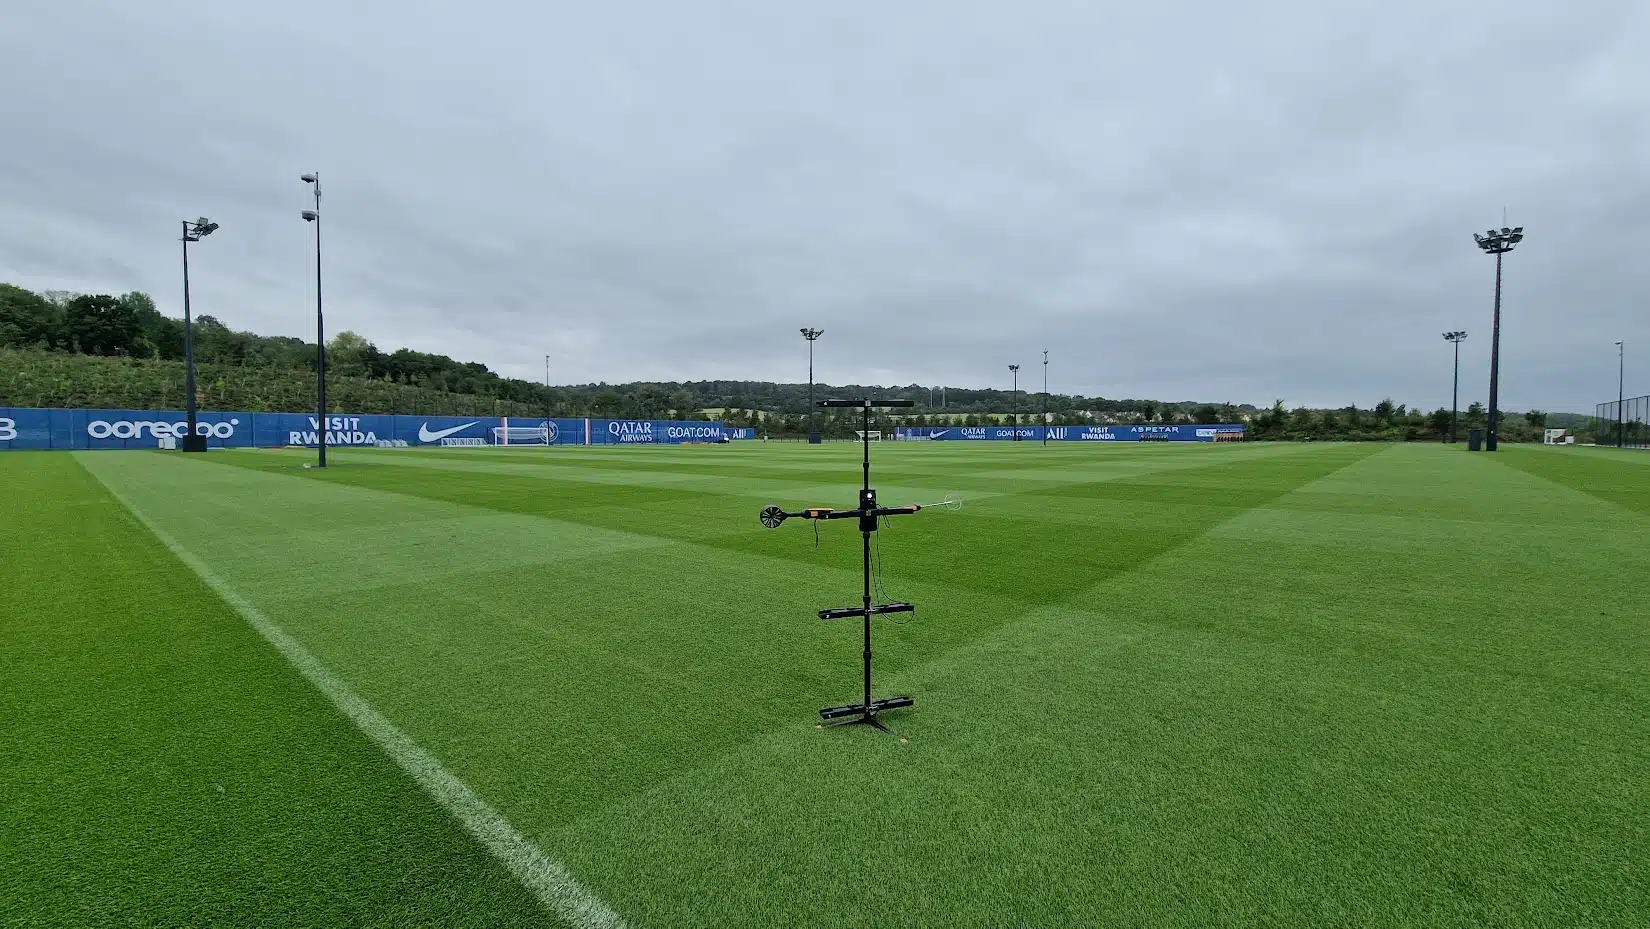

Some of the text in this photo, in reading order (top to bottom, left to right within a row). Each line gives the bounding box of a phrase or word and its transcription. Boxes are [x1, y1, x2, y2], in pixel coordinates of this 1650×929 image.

[308, 417, 359, 430] VISIT
[608, 421, 652, 436] QATAR
[289, 431, 376, 445] RWANDA
[668, 426, 720, 438] GOAT.COM
[961, 428, 986, 436] QATAR
